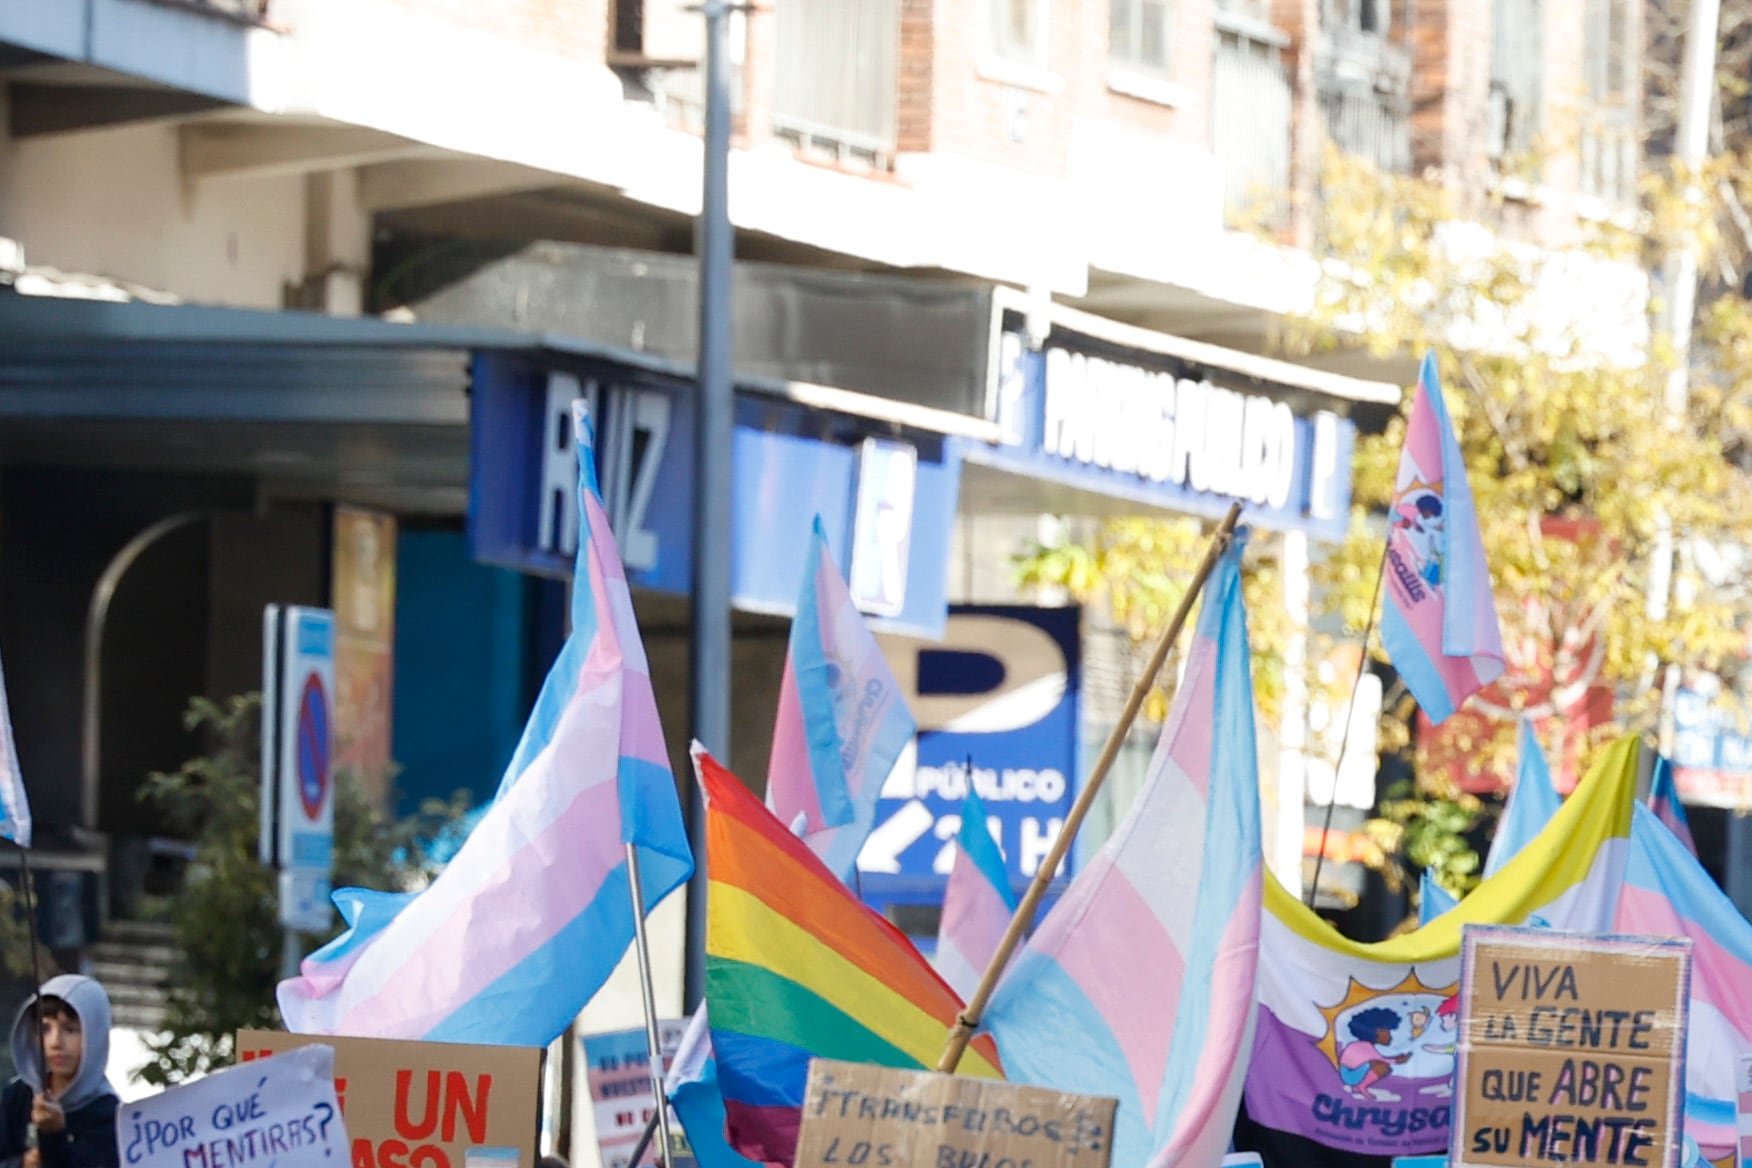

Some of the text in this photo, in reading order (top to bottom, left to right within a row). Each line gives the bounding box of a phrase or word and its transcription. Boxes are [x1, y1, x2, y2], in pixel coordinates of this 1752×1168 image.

[1493, 962, 1578, 1000] VIVA
[1484, 1005, 1655, 1049] LA GENTE
[394, 1069, 492, 1144] UN
[1482, 1058, 1653, 1111] QUE ABRE
[127, 1076, 268, 1164] ¿POR QUÉ
[1472, 1127, 1511, 1154] SU
[1519, 1112, 1657, 1168] MENTE
[823, 1138, 892, 1167] LOS
